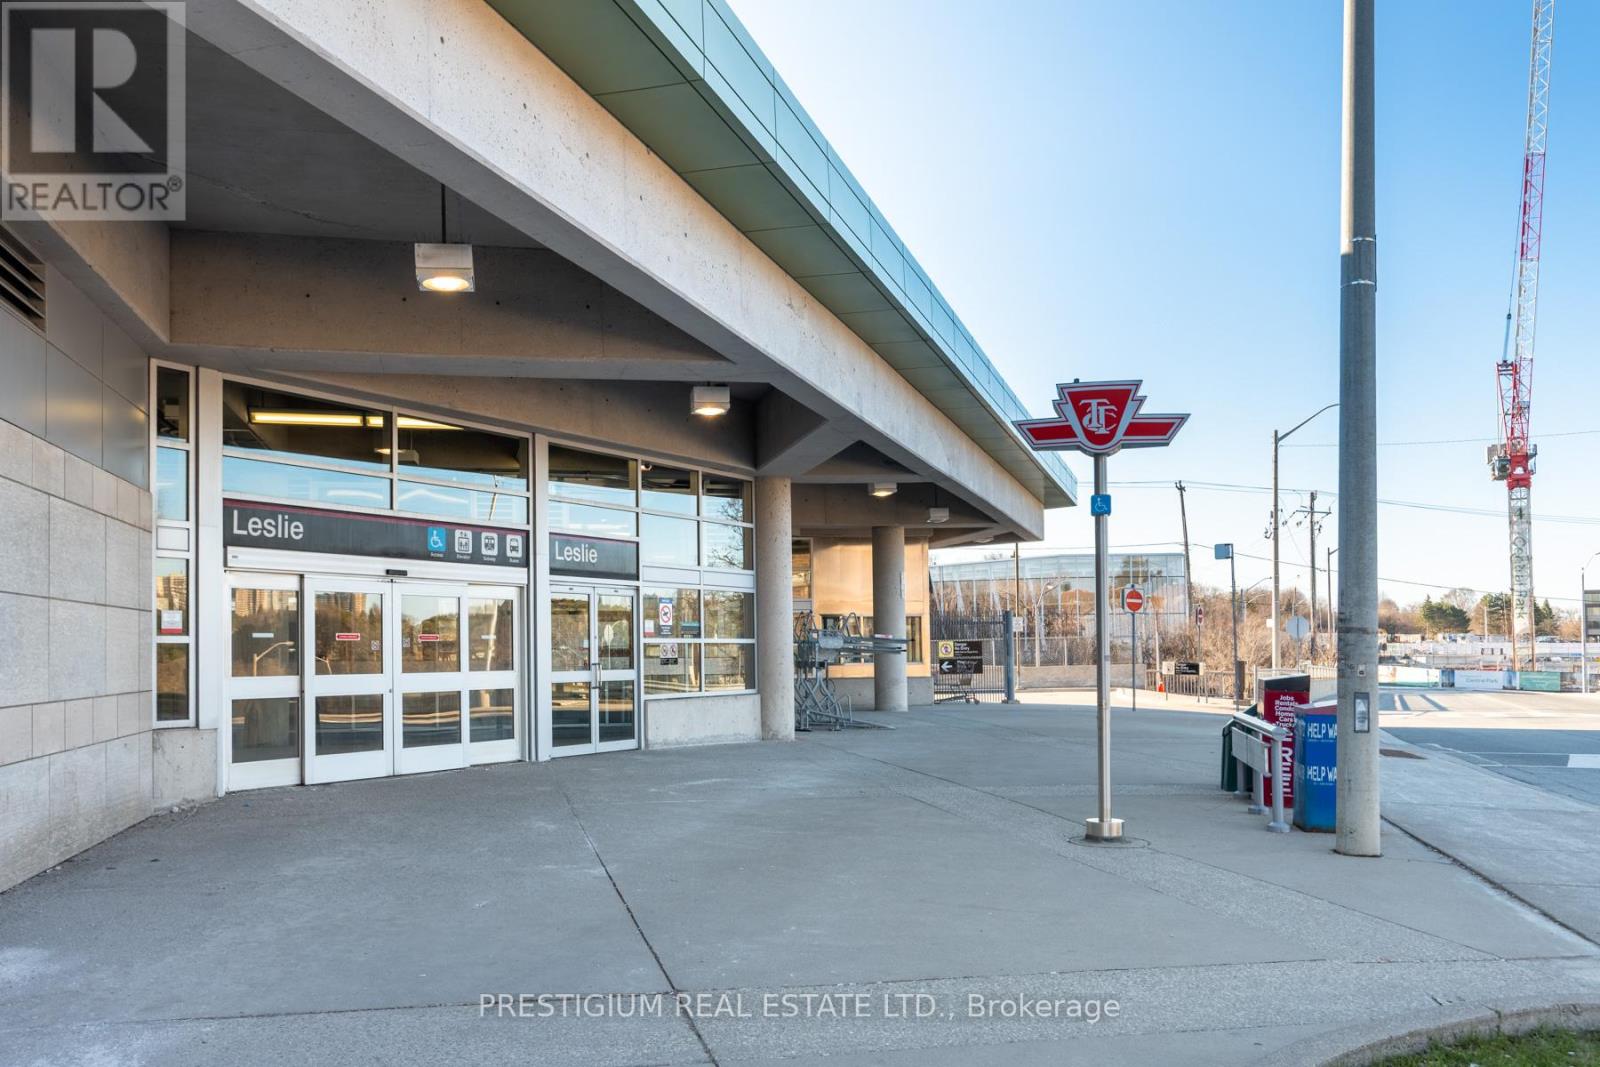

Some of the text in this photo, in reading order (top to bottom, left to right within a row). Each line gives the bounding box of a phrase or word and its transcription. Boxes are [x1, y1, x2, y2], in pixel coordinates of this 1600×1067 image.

[232, 509, 304, 540] Leslie
[555, 540, 598, 564] Leslie
[1307, 722, 1326, 739] HELP
[1327, 722, 1338, 739] WA
[1306, 765, 1326, 782] HELP
[1326, 766, 1338, 782] WA
